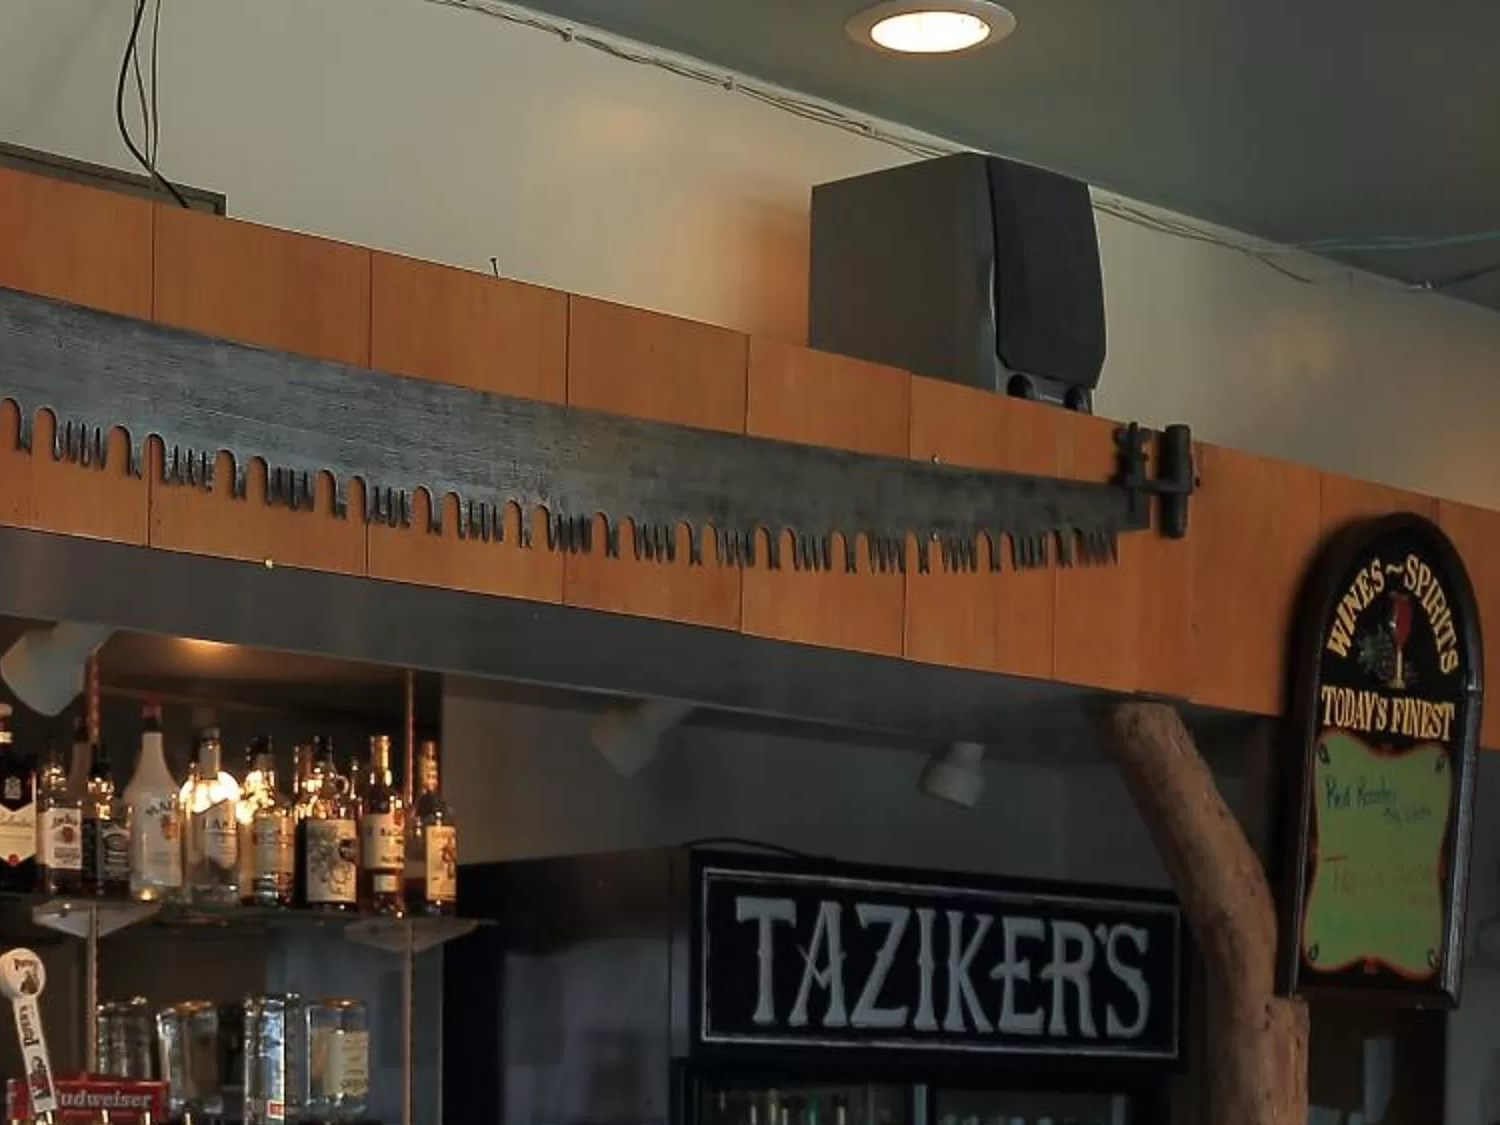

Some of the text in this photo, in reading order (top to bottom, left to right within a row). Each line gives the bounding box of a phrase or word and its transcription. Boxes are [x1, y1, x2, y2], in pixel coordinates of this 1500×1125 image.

[1326, 555, 1459, 674] WINES SPIRITS
[1391, 696, 1455, 742] FINEST
[735, 896, 1152, 1039] TAZIKER'S
[53, 1088, 153, 1108] udweiser
